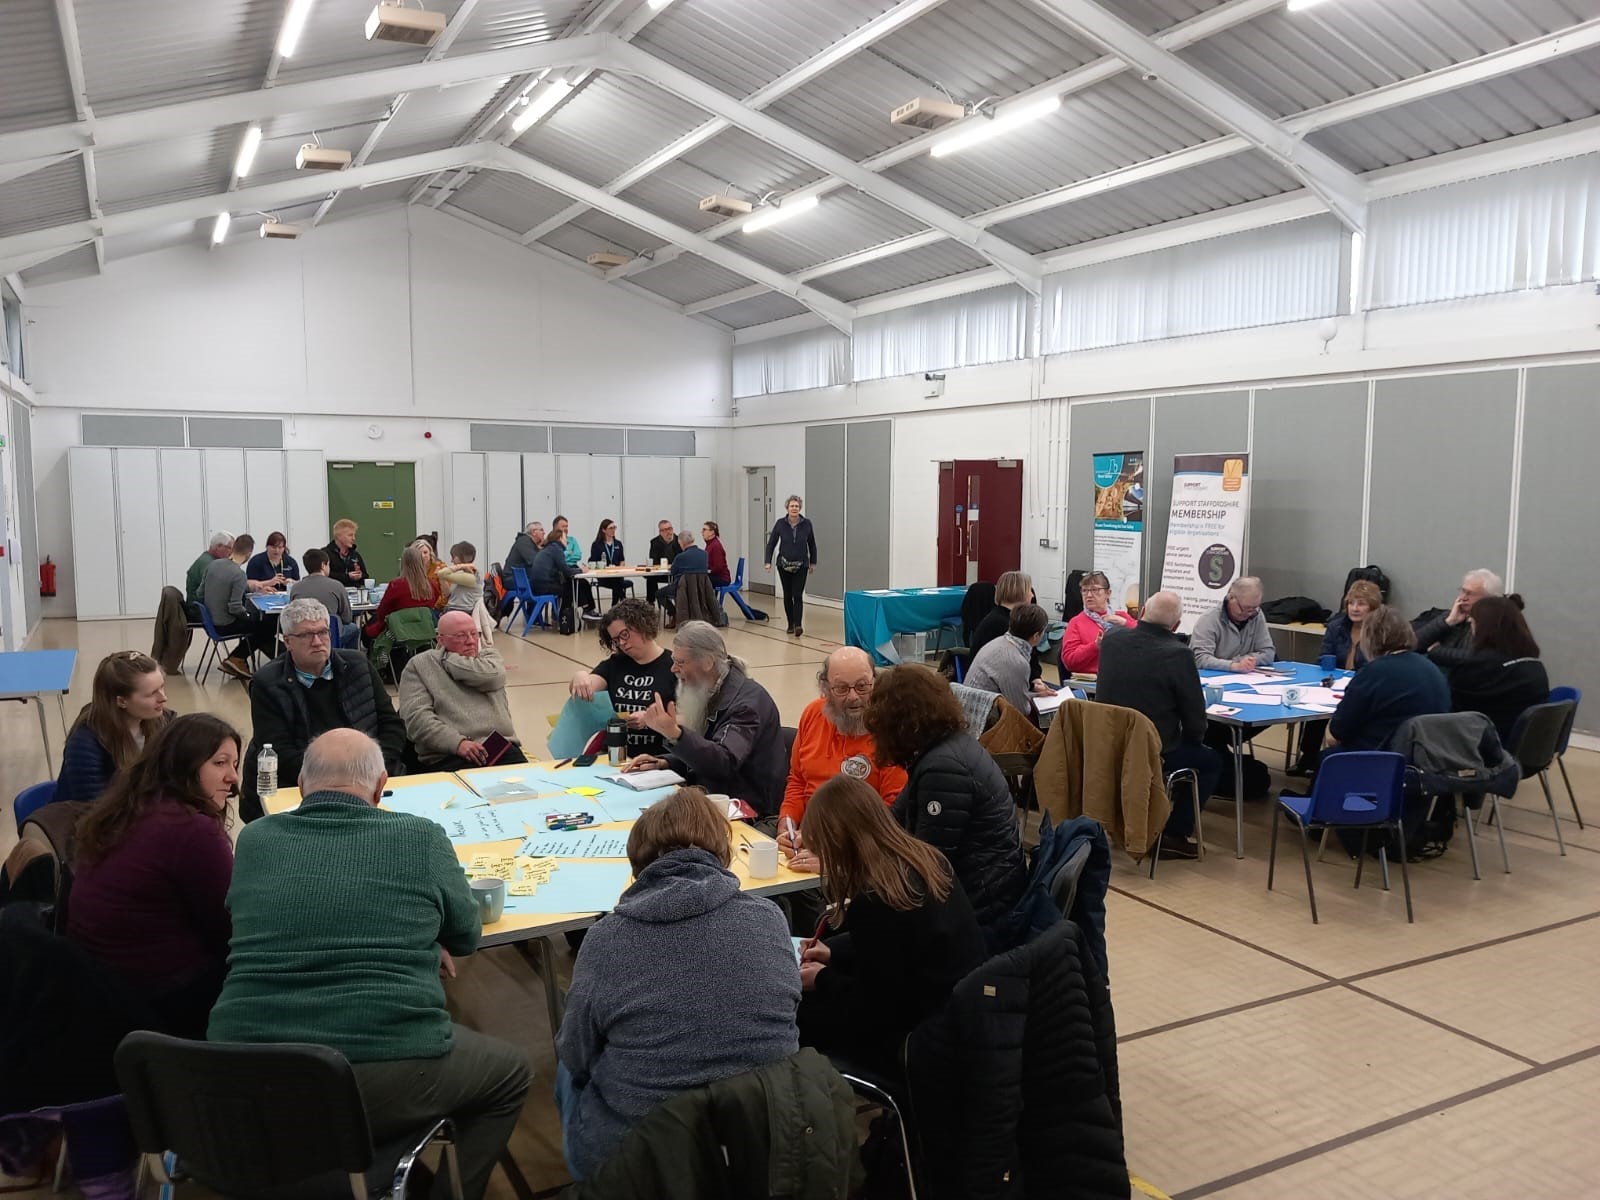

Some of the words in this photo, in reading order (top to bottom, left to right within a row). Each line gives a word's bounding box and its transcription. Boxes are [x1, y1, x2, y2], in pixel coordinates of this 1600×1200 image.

[1197, 500, 1240, 508] STAFFORDSHIRE
[1171, 509, 1227, 519] MEMBERSHIP
[624, 674, 654, 687] GOD
[615, 687, 652, 701] SAVE
